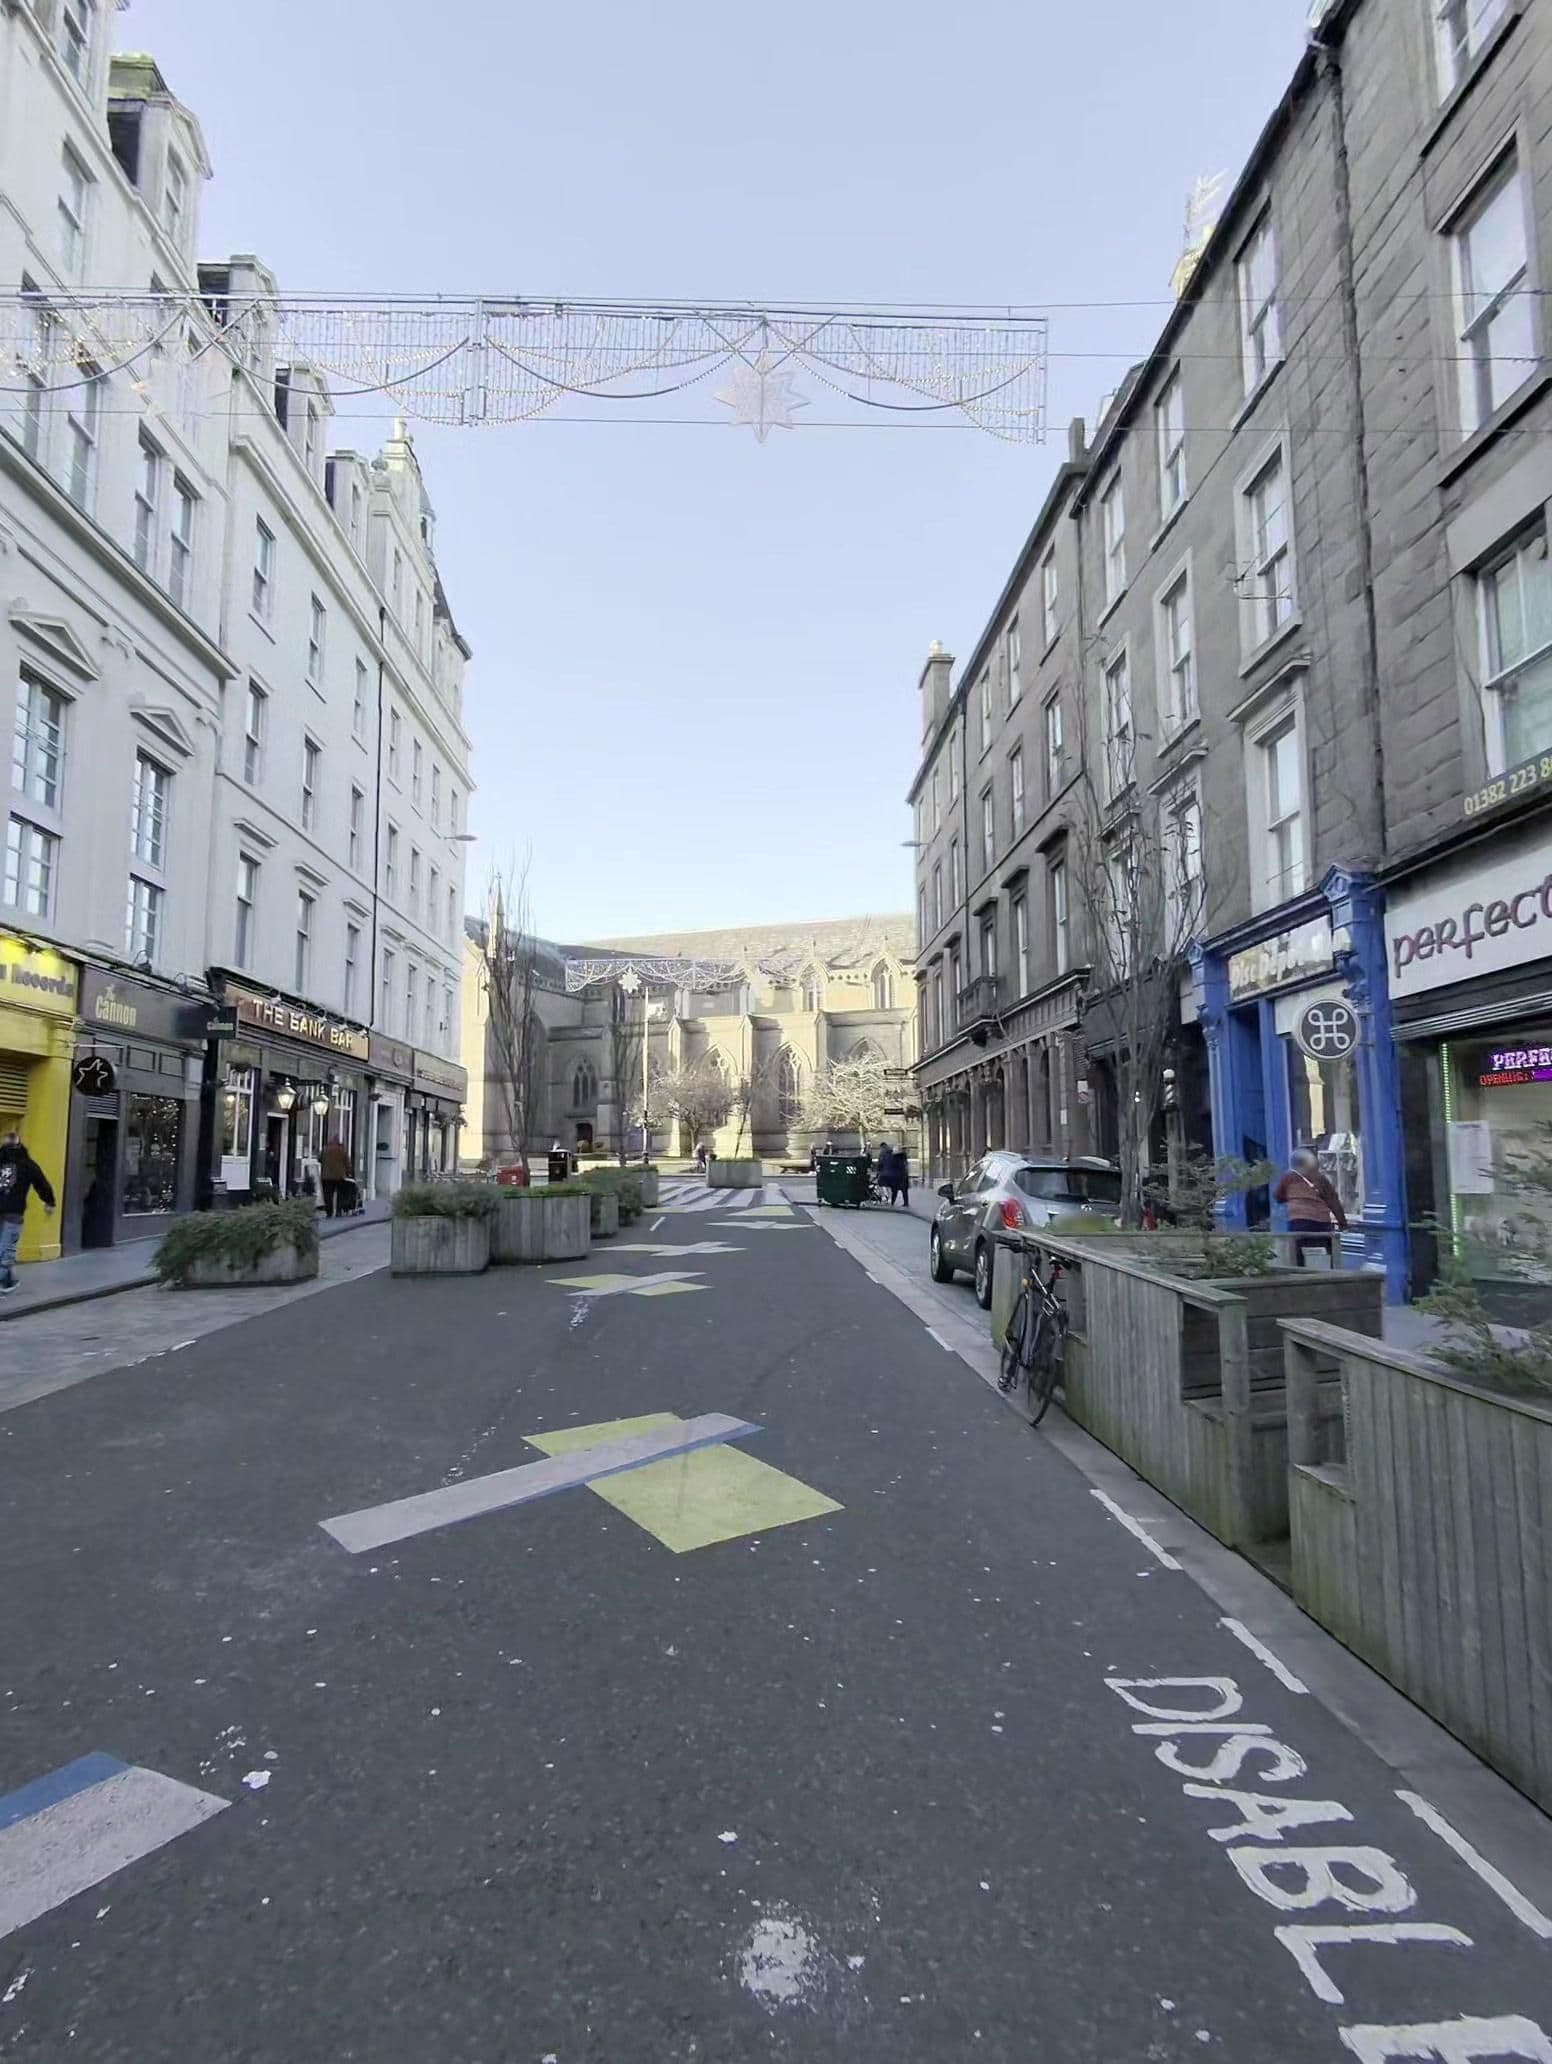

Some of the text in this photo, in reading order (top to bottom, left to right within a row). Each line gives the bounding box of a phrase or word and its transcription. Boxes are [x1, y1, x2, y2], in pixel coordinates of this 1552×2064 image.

[1464, 780, 1506, 815] 01382
[1509, 768, 1537, 793] 223
[253, 1000, 353, 1049] THE BANK BAR
